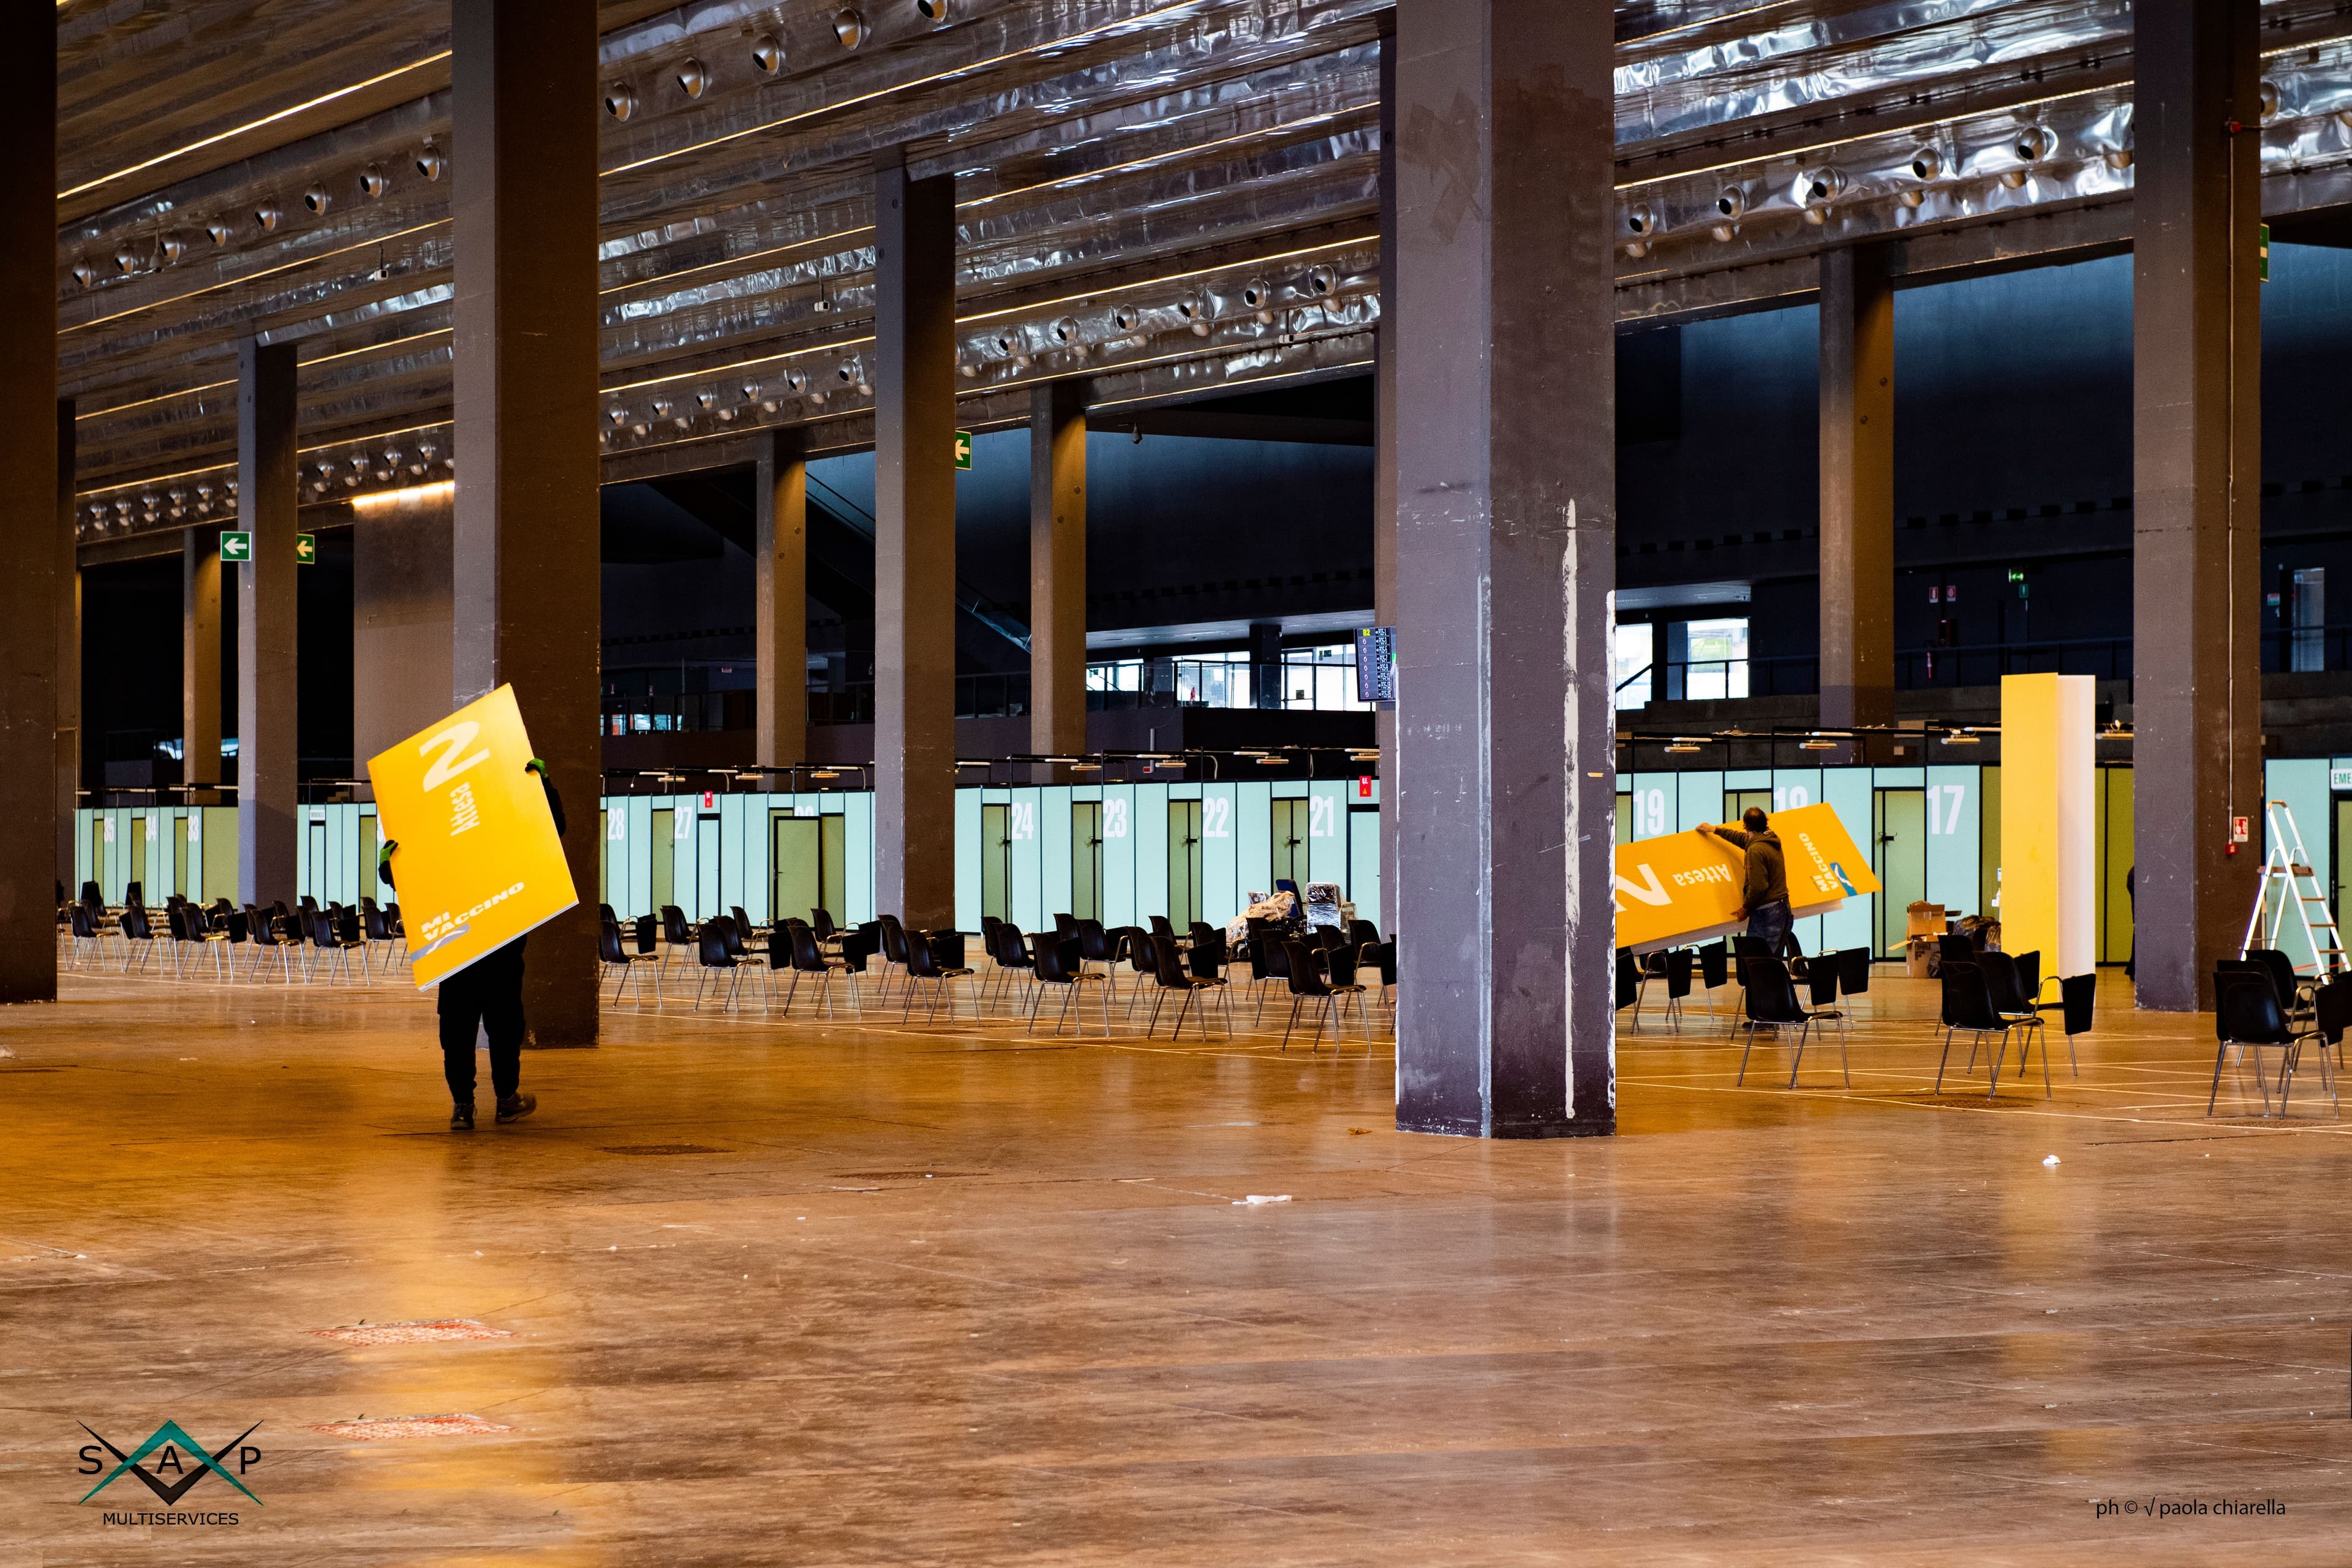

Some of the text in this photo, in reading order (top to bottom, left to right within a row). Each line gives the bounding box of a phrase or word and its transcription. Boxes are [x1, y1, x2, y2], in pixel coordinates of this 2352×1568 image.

[419, 720, 490, 793] 2
[145, 815, 156, 842] 34
[187, 815, 199, 842] 33
[450, 782, 480, 837] Attesa
[607, 807, 625, 840] 28
[674, 806, 693, 839] 27
[1012, 802, 1033, 840] 24
[1102, 798, 1127, 838] 23
[1202, 797, 1229, 837] 22
[1310, 796, 1334, 837] 21
[1633, 788, 1665, 835] 19
[1926, 785, 1965, 835] 17
[104, 817, 115, 843] 35
[1672, 864, 1732, 886] Attesa
[1798, 832, 1839, 890] VACCINO
[1812, 875, 1830, 892] MI
[421, 911, 451, 933] MI
[423, 881, 524, 941] VACCINO
